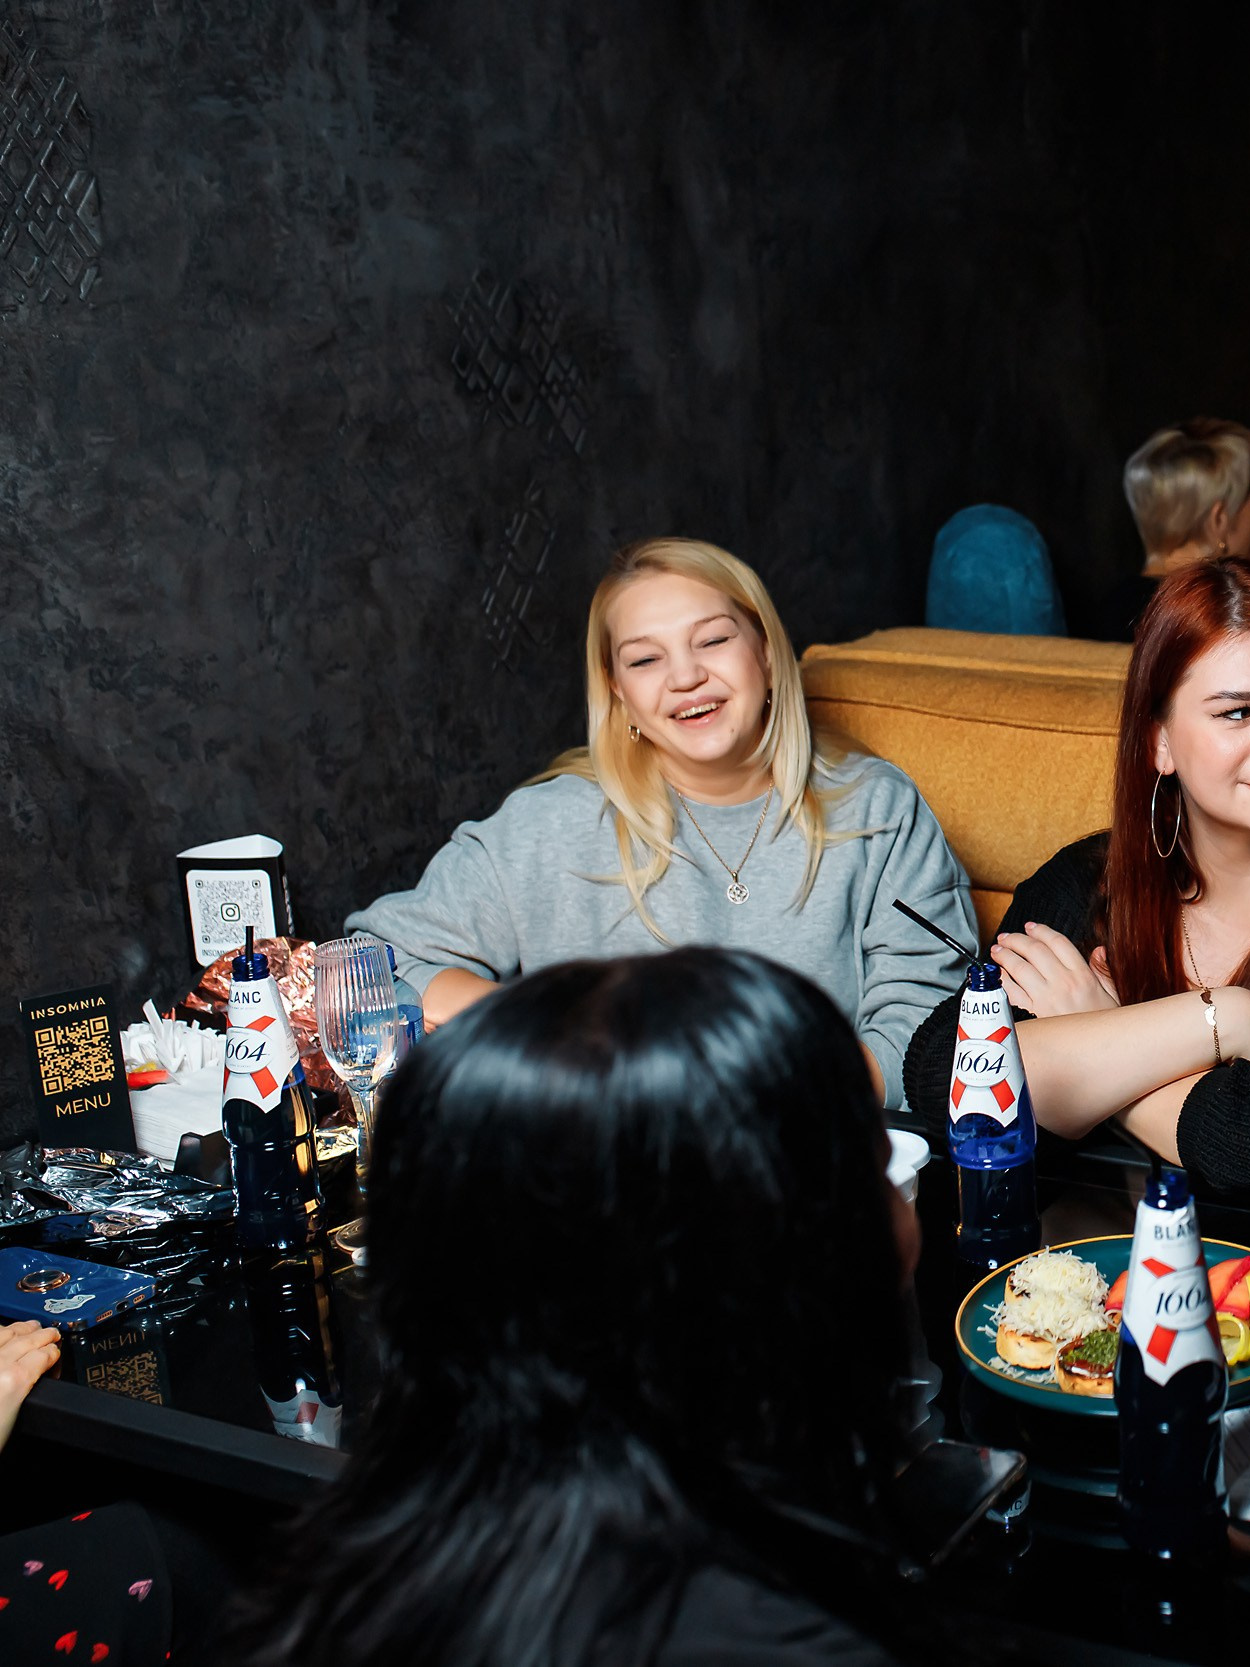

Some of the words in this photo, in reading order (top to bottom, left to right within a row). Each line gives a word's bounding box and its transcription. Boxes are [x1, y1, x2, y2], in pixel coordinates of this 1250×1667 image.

[30, 996, 106, 1020] INSOMNIA
[961, 999, 1001, 1015] BLANC
[226, 1037, 267, 1062] 664
[956, 1049, 1008, 1075] 1664
[55, 1092, 112, 1118] MENU
